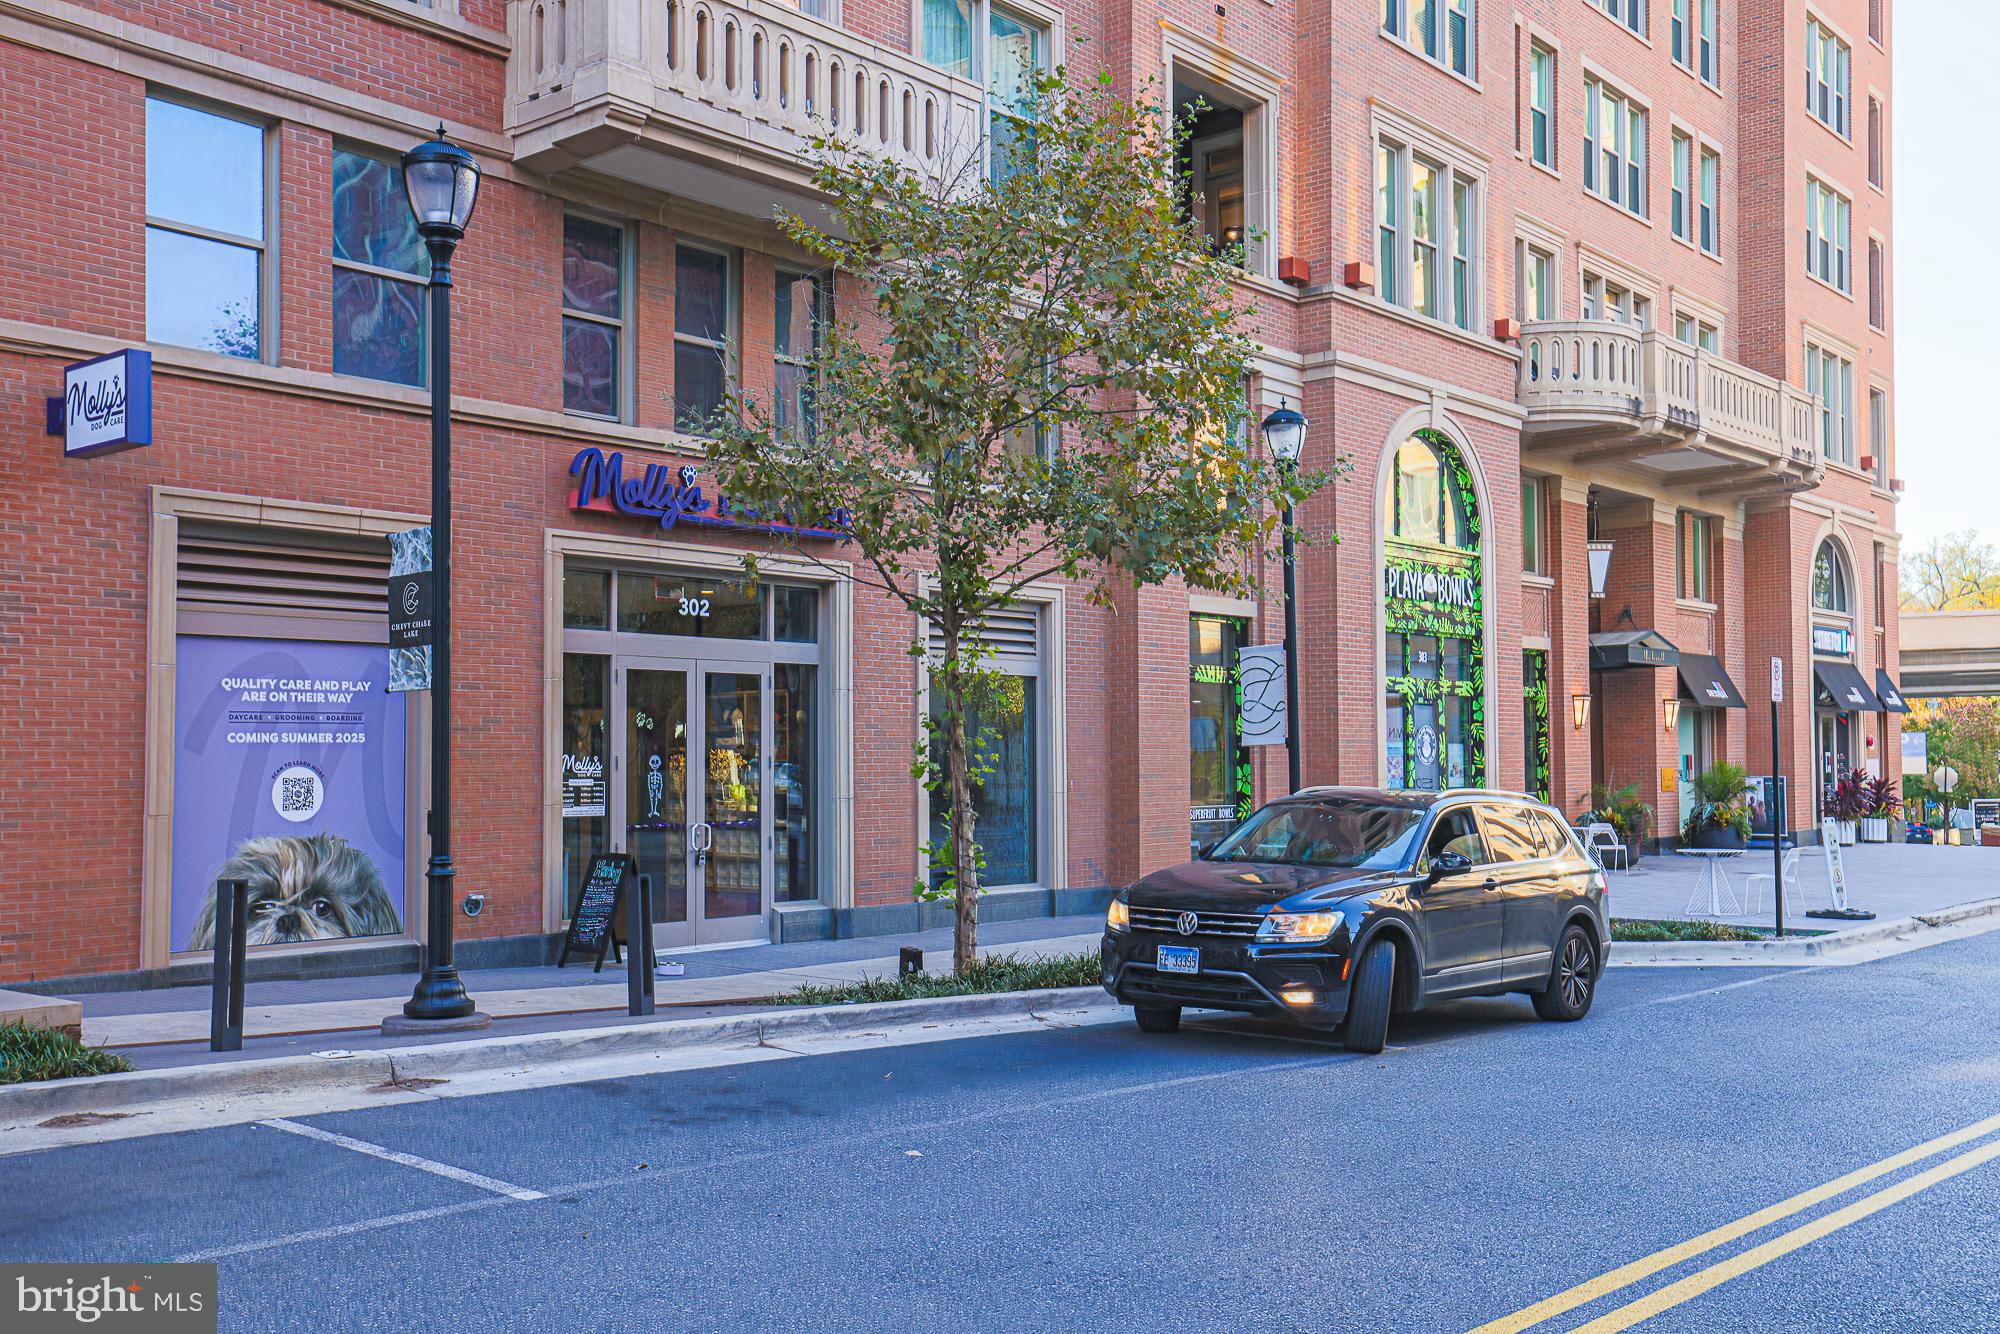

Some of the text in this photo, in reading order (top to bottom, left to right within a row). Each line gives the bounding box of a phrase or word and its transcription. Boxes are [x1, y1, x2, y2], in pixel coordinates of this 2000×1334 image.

[67, 375, 125, 427] Molly's
[91, 416, 124, 430] DOG CARE
[569, 447, 711, 530] Molly's
[1388, 567, 1474, 607] PLAYA BOWLS
[678, 597, 710, 617] 302
[392, 620, 431, 630] CHEVY CHASE
[221, 678, 371, 692] QUALITY CARE AND PLAY
[241, 691, 354, 704] ARE ON THEIR WAY
[227, 732, 366, 743] COMING SUMMER 2025
[562, 754, 603, 777] Molly's
[1190, 807, 1234, 820] SUPERFRUIT BOWLS
